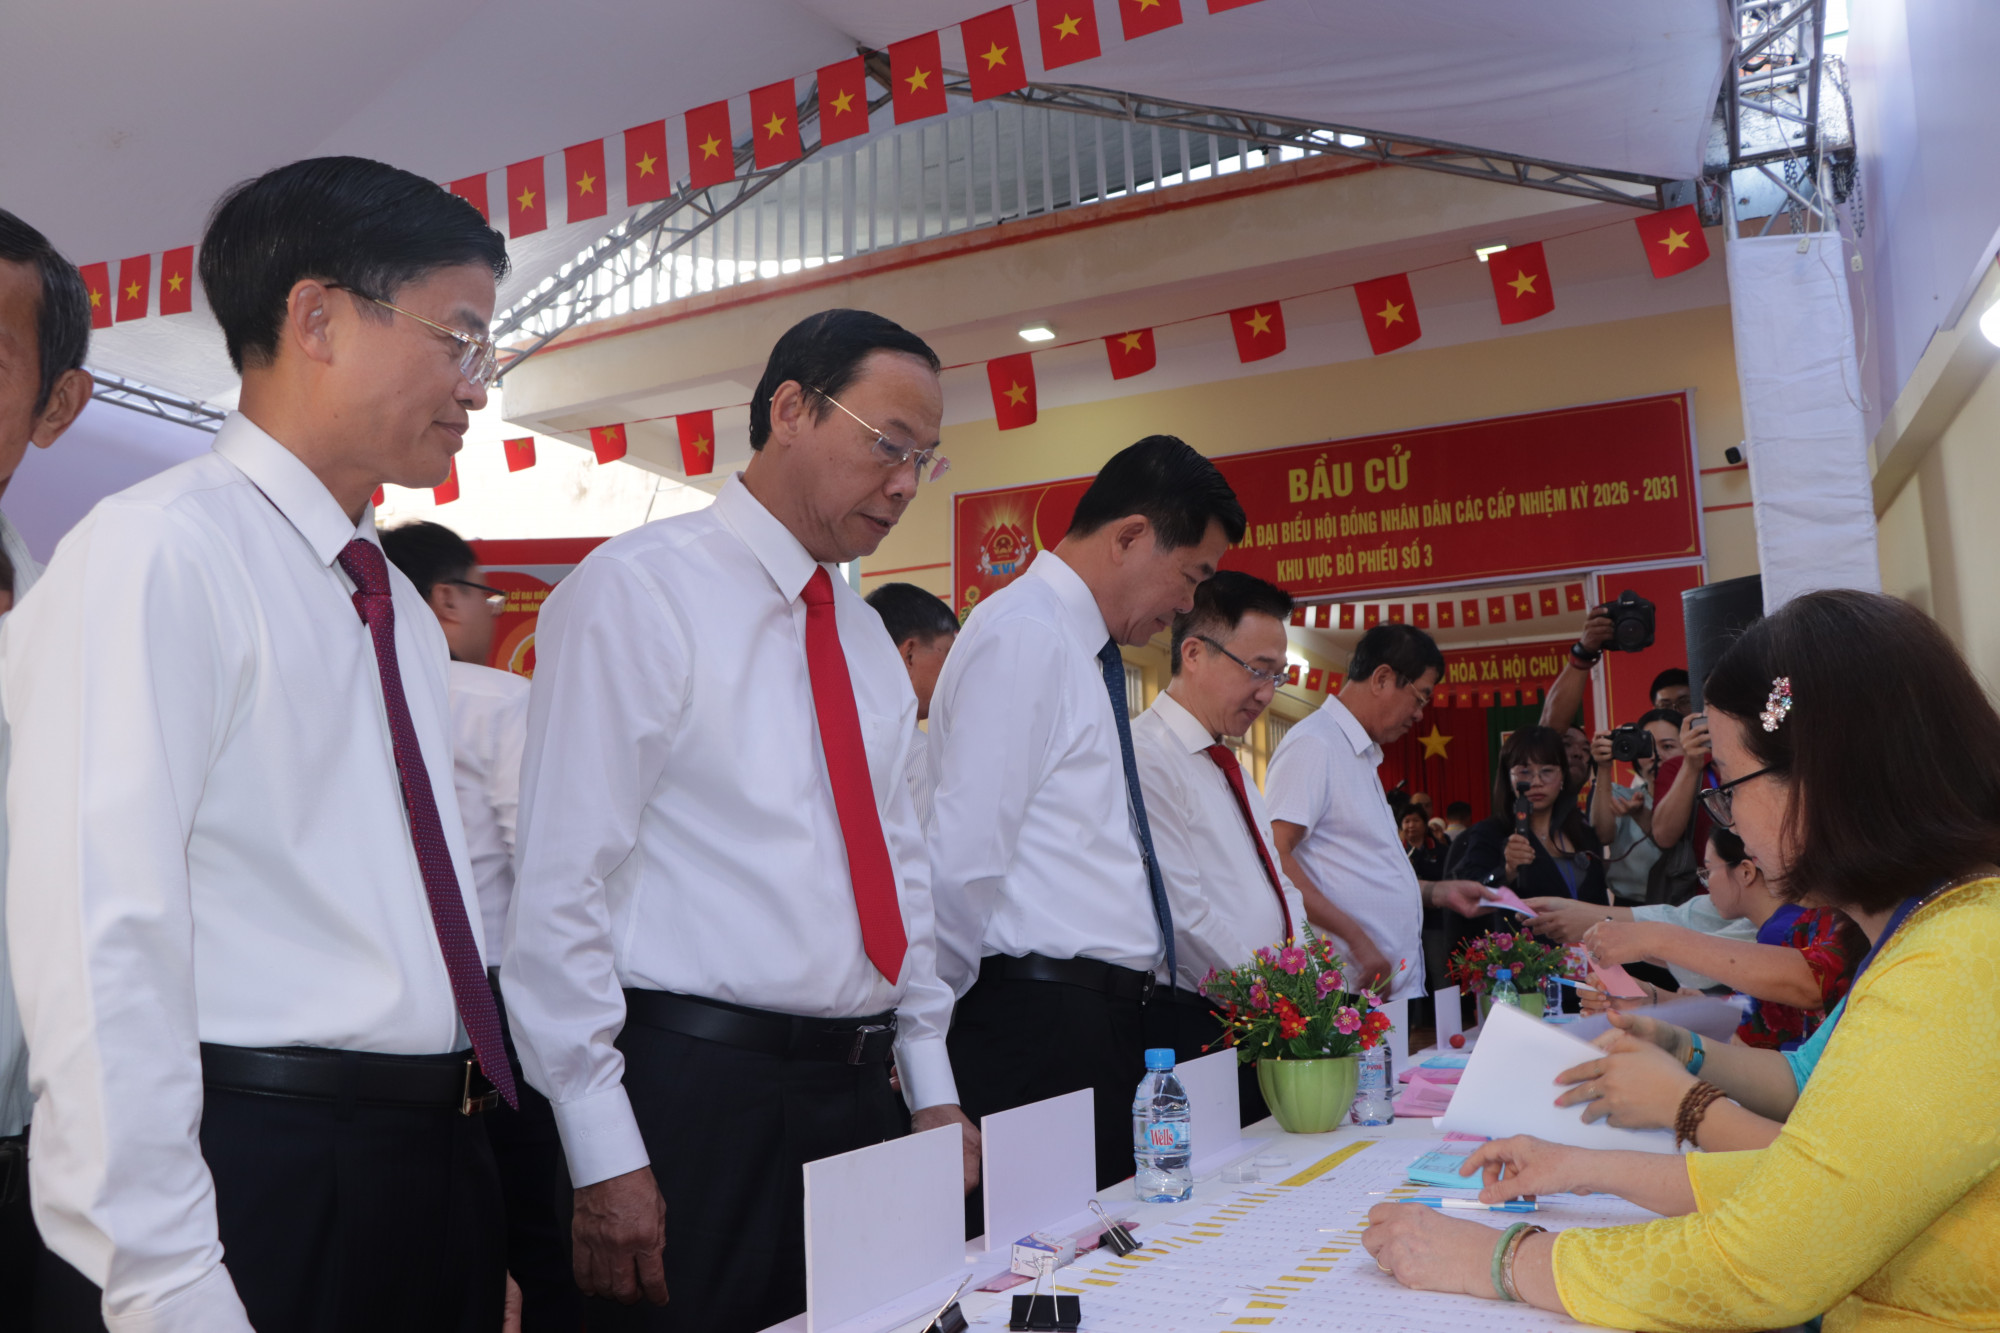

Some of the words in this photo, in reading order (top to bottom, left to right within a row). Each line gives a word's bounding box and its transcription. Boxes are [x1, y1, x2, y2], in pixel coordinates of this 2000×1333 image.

[1288, 453, 1353, 503] BẦU
[1364, 443, 1411, 493] CỬ
[1256, 523, 1278, 550] ĐẠI
[1281, 511, 1311, 543] BIỂU
[1314, 512, 1337, 543] HỘI
[1381, 502, 1419, 532] NHÂN
[1422, 499, 1452, 527] DÂN
[1455, 494, 1484, 523] CÁC
[1487, 487, 1516, 519] CẤP
[1519, 484, 1567, 518] NHIỆM
[1570, 480, 1589, 510] KỲ
[1593, 480, 1630, 507] 2026
[1643, 474, 1678, 502] 2031
[991, 563, 1015, 575] XVI
[1277, 557, 1303, 583] KHU
[1306, 553, 1333, 583] VỰC
[1336, 545, 1354, 576] BỎ
[1358, 541, 1398, 574] PHIẾU
[1402, 537, 1420, 569] SỐ
[1424, 544, 1433, 568] 3
[1449, 657, 1478, 684] HÒA
[1481, 654, 1499, 681] XÃ
[1502, 654, 1526, 684] HỘI
[1529, 647, 1558, 676] CHỦ
[1150, 1129, 1173, 1146] Wells
